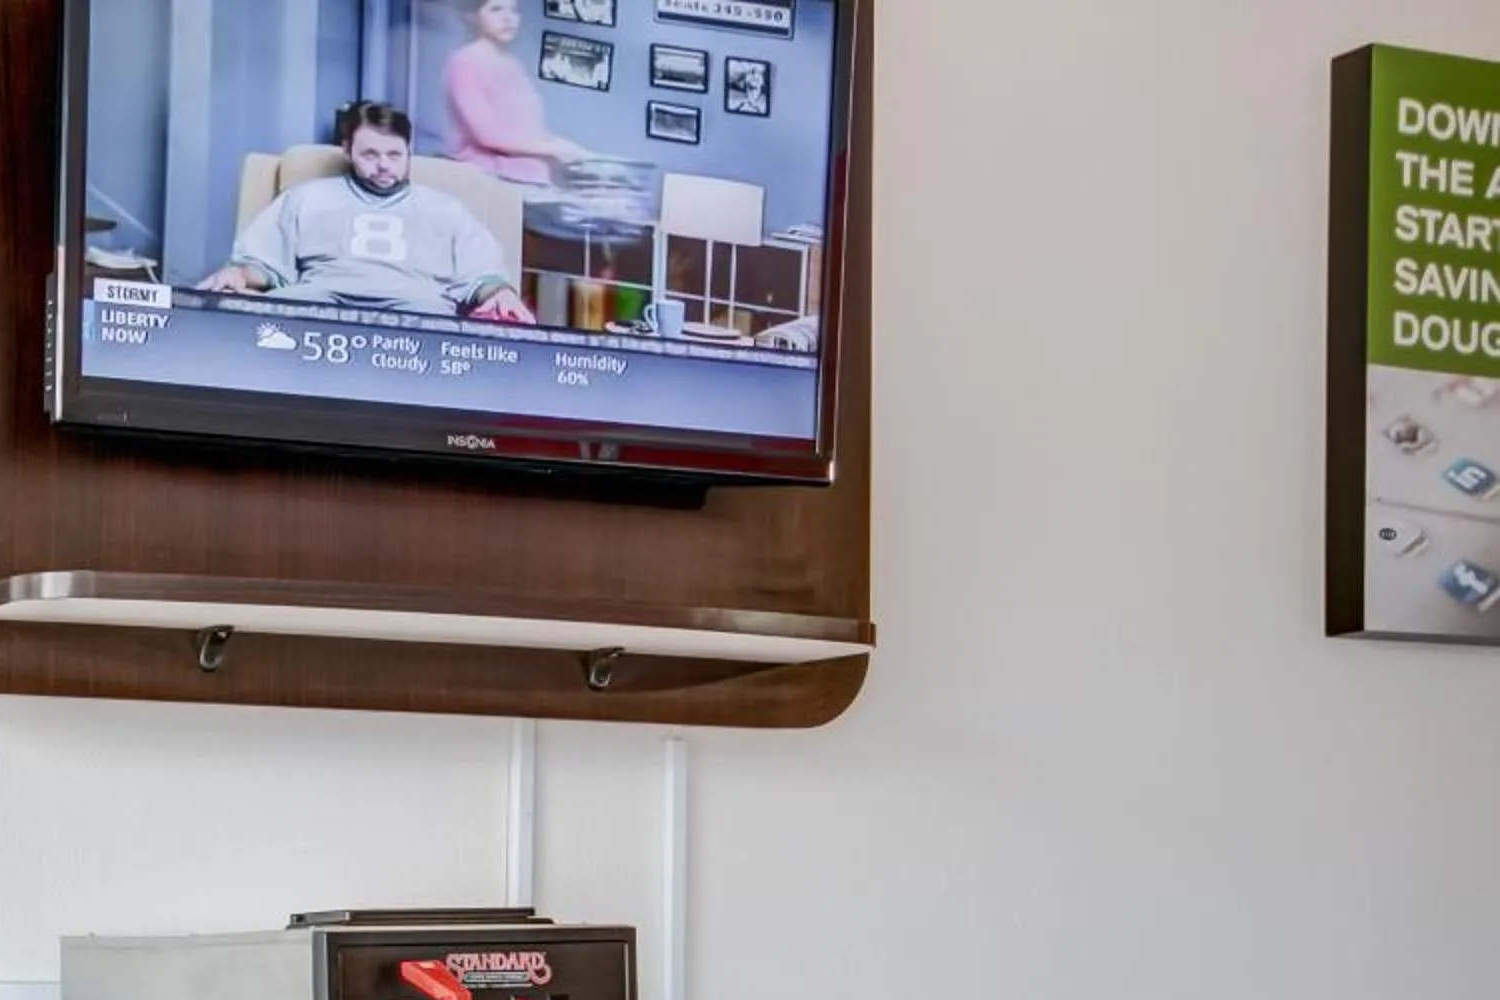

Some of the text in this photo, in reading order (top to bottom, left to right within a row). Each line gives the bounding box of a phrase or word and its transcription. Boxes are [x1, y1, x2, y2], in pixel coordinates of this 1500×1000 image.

[1397, 97, 1500, 147] DOW
[1395, 150, 1475, 196] THE
[351, 213, 406, 261] 8
[101, 309, 169, 329] LIBERTY
[101, 327, 147, 344] NOW
[372, 334, 421, 355] Partly
[371, 353, 429, 375] Cloudy
[440, 341, 519, 364] Feels like
[556, 352, 628, 376] Humidity
[557, 371, 590, 386] 60%
[446, 951, 552, 986] STANDARD
